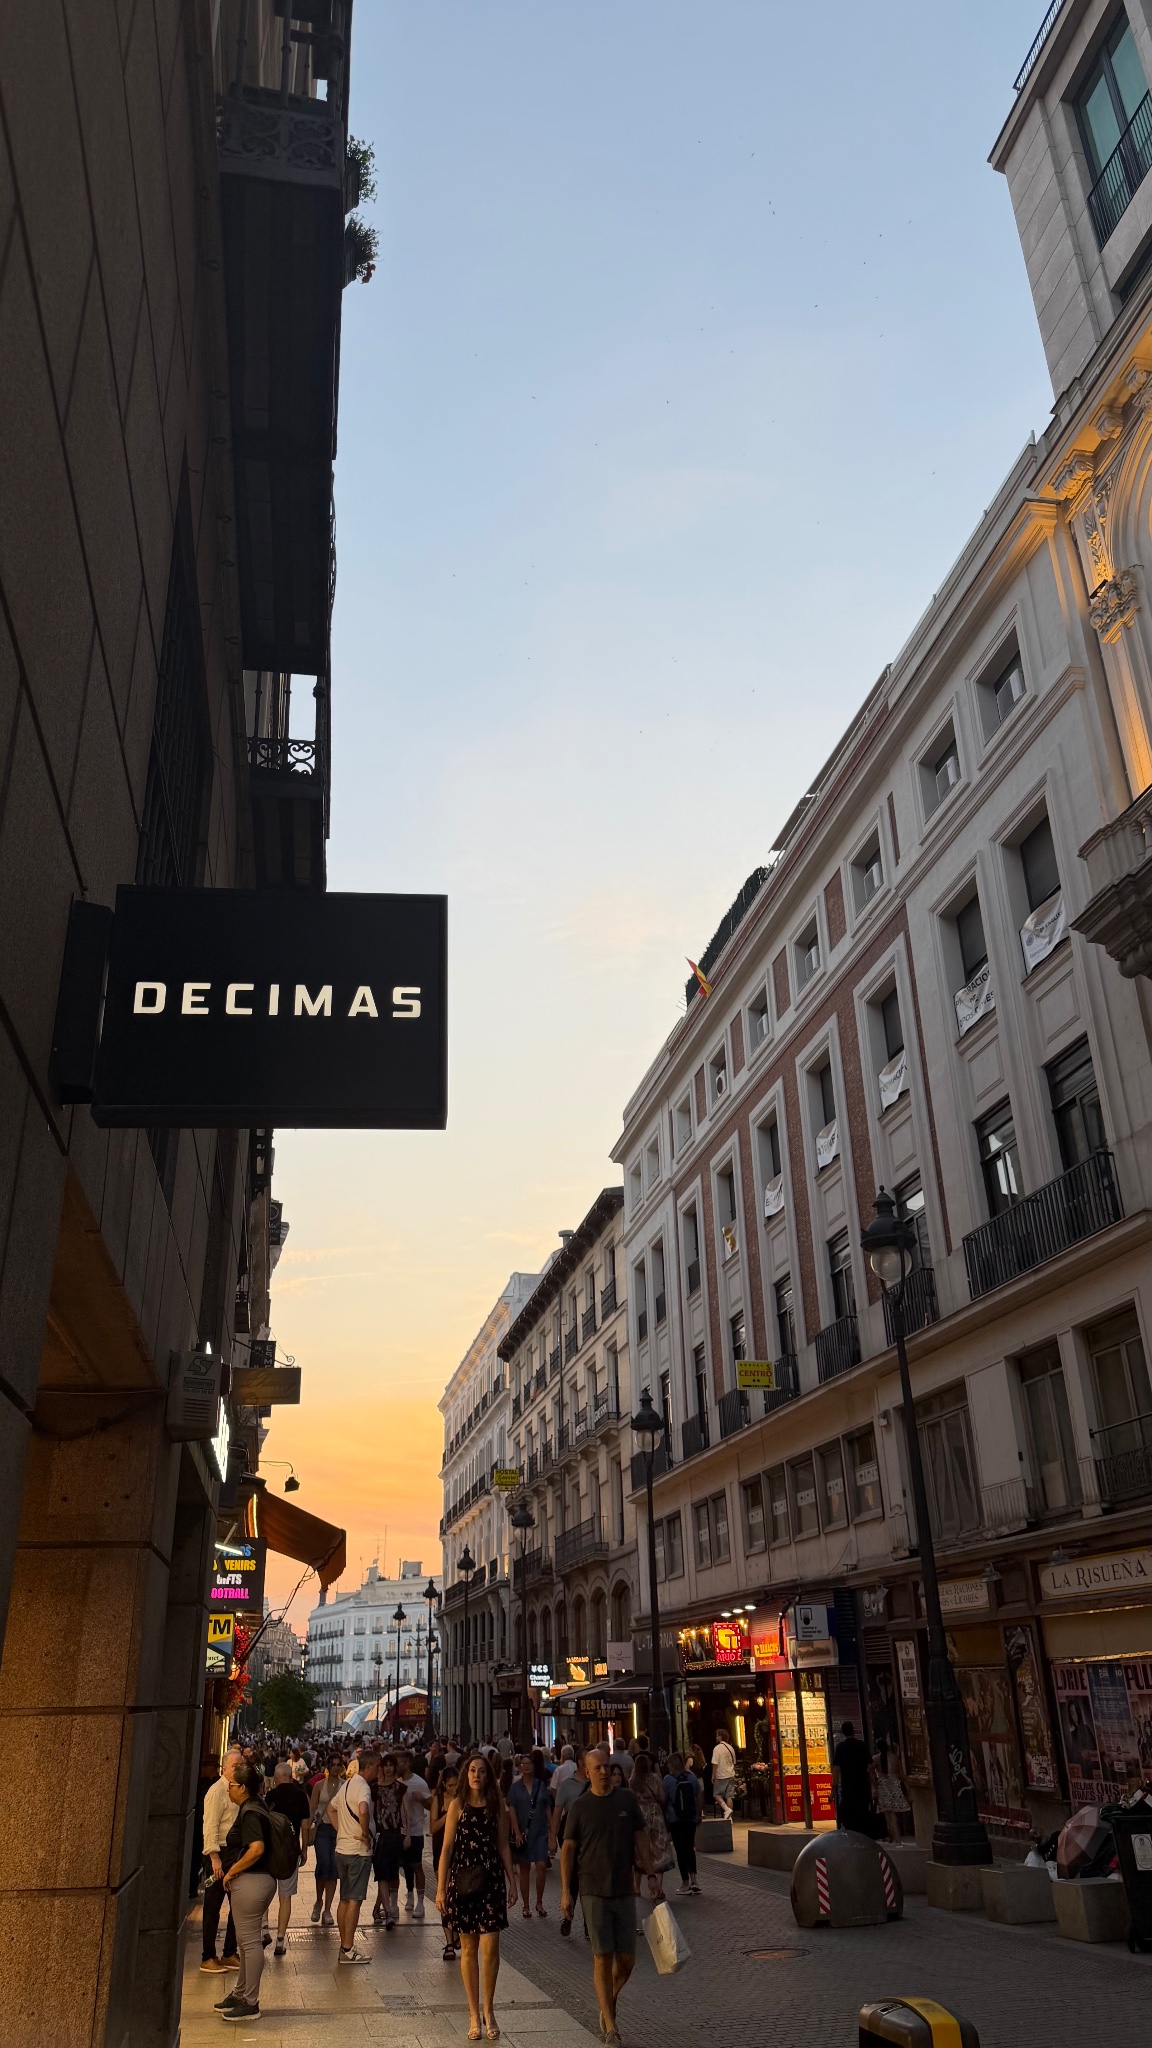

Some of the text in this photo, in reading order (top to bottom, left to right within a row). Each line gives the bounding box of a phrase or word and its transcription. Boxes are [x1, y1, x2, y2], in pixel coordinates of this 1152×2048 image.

[133, 981, 422, 1018] DECIMAS
[1052, 1558, 1148, 1589] LA RISUEÑA
[211, 1587, 250, 1599] OOTBALL
[580, 1699, 600, 1710] BEST
